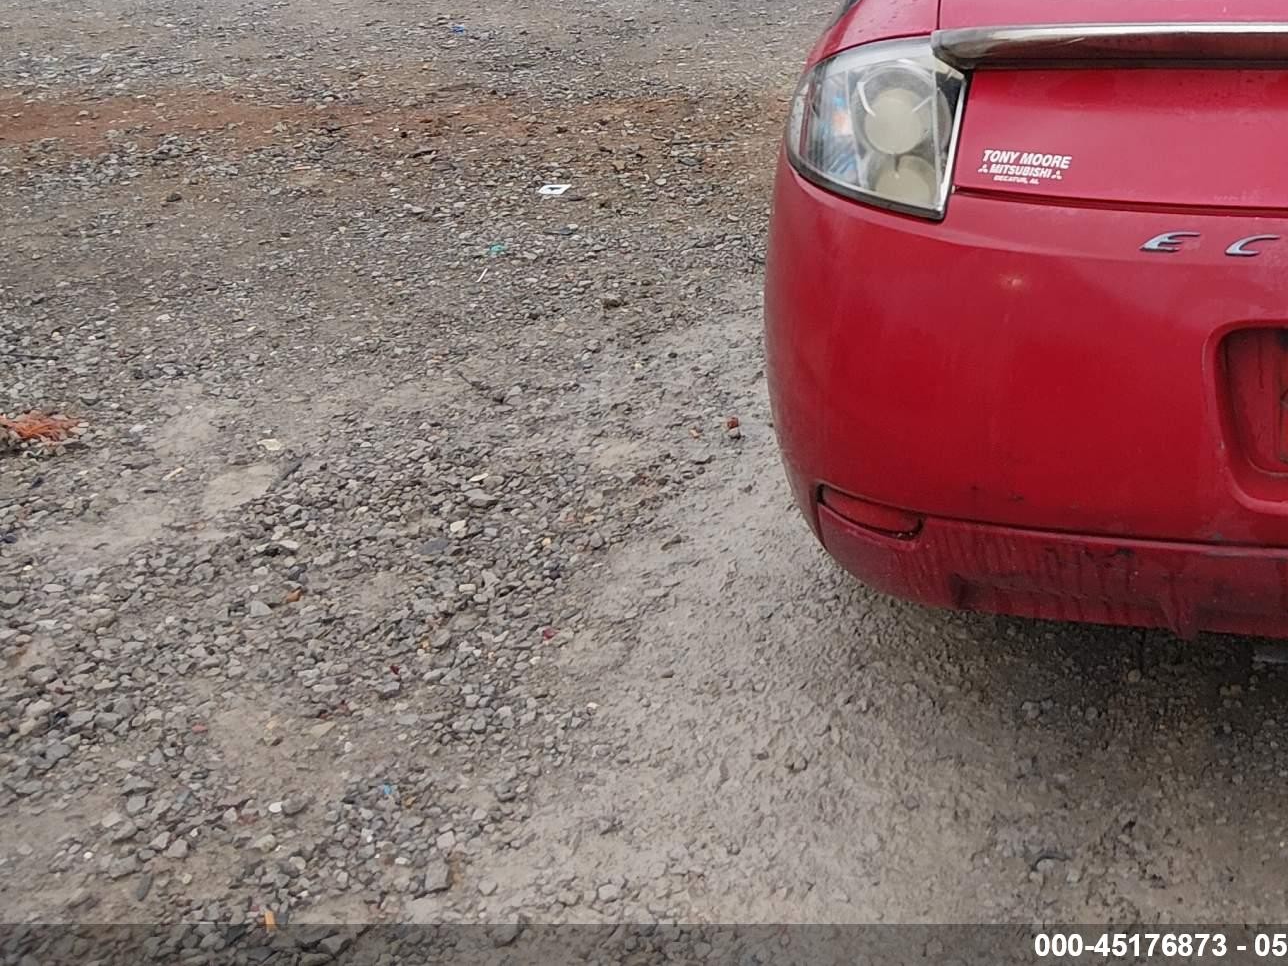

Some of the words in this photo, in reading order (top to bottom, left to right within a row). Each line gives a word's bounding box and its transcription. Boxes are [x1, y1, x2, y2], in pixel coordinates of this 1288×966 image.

[983, 150, 1020, 164] TONY
[1019, 152, 1072, 169] MOORE
[989, 164, 1052, 179] MITSUBISHI
